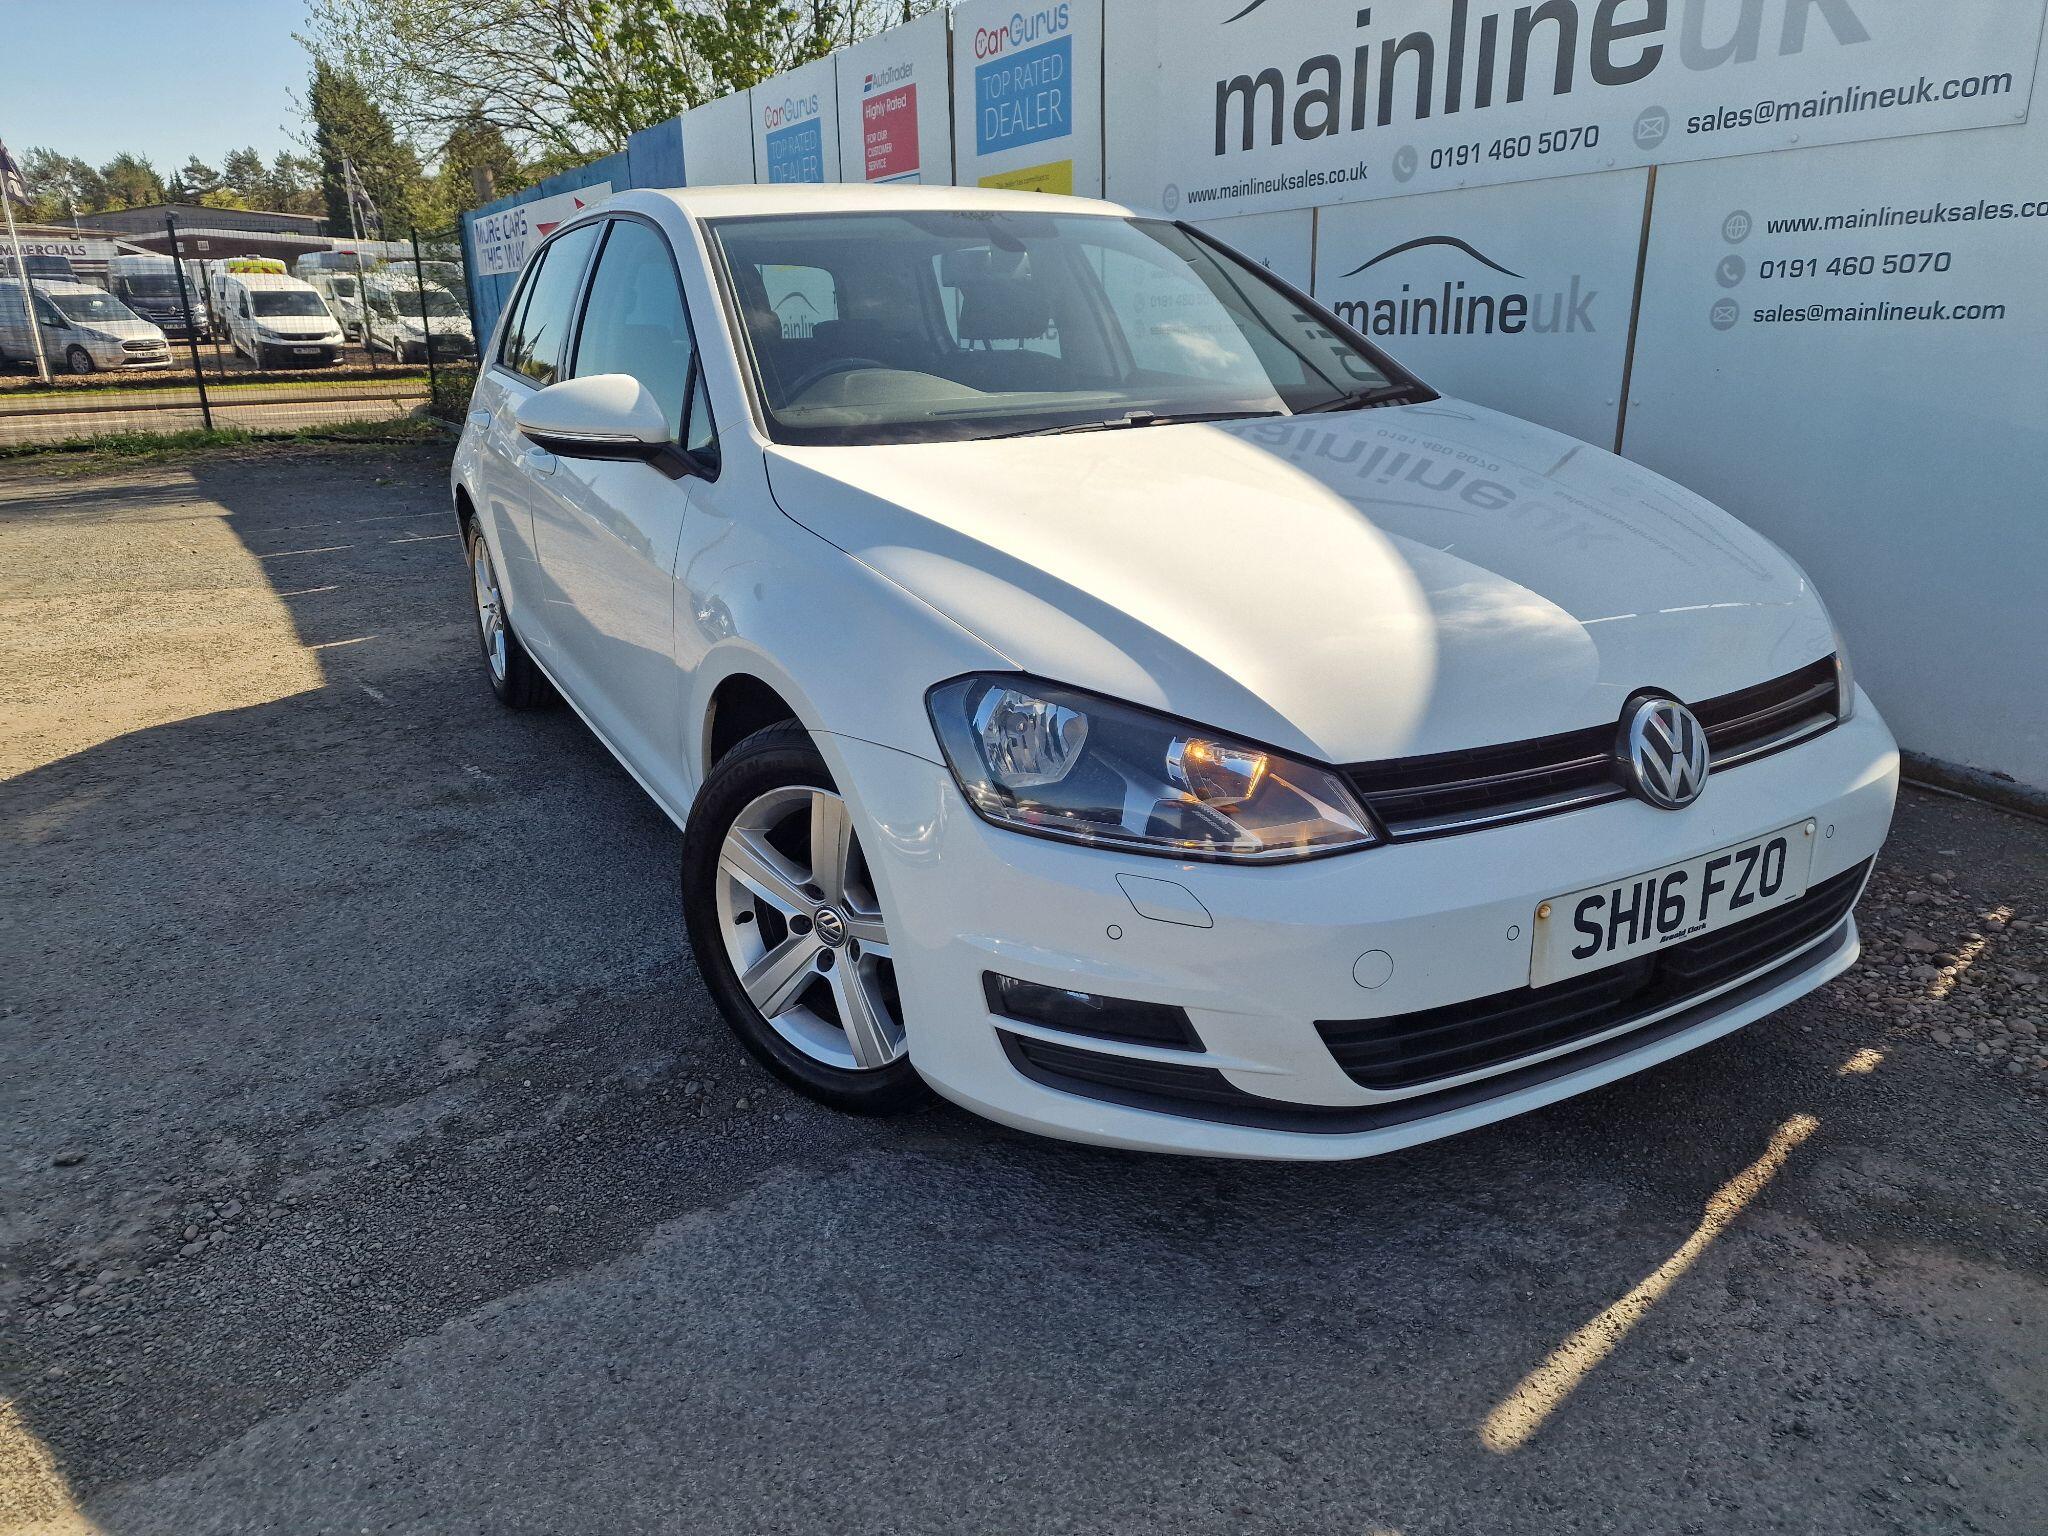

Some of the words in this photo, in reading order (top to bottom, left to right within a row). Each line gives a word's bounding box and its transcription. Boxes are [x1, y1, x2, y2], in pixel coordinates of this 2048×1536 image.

[974, 3, 1069, 59] CarGurus
[872, 62, 914, 89] AutoTrader
[982, 70, 1011, 100] TOP
[1014, 54, 1063, 92] RATED
[764, 94, 819, 129] CarGurus
[865, 100, 885, 120] Highly
[886, 93, 907, 113] Rated
[985, 89, 1063, 141] DEALER
[770, 139, 788, 160] TOP
[789, 130, 817, 153] RATED
[866, 133, 877, 144] FOR
[867, 143, 893, 158] CUSTOMER
[1187, 161, 1368, 204] www.mainlineuksales.co.uk
[1430, 143, 1481, 170] 0191
[1488, 137, 1531, 162] 460
[1538, 125, 1600, 155] 5070
[1686, 72, 2013, 134] sales@mainlineuk.com
[773, 156, 819, 183] DEALER
[868, 157, 887, 172] SERVICE
[503, 208, 529, 240] CARS
[481, 246, 504, 271] THIS
[504, 240, 526, 270] WAY
[1759, 258, 1817, 280] 0191
[1826, 256, 1875, 277] 460
[1882, 251, 1952, 275] 5070
[1334, 274, 1599, 335] mainlineuk
[1753, 300, 2007, 323] sales@mainlineuk.com
[1571, 870, 1689, 960] SH16
[1698, 836, 1788, 922] FZO
